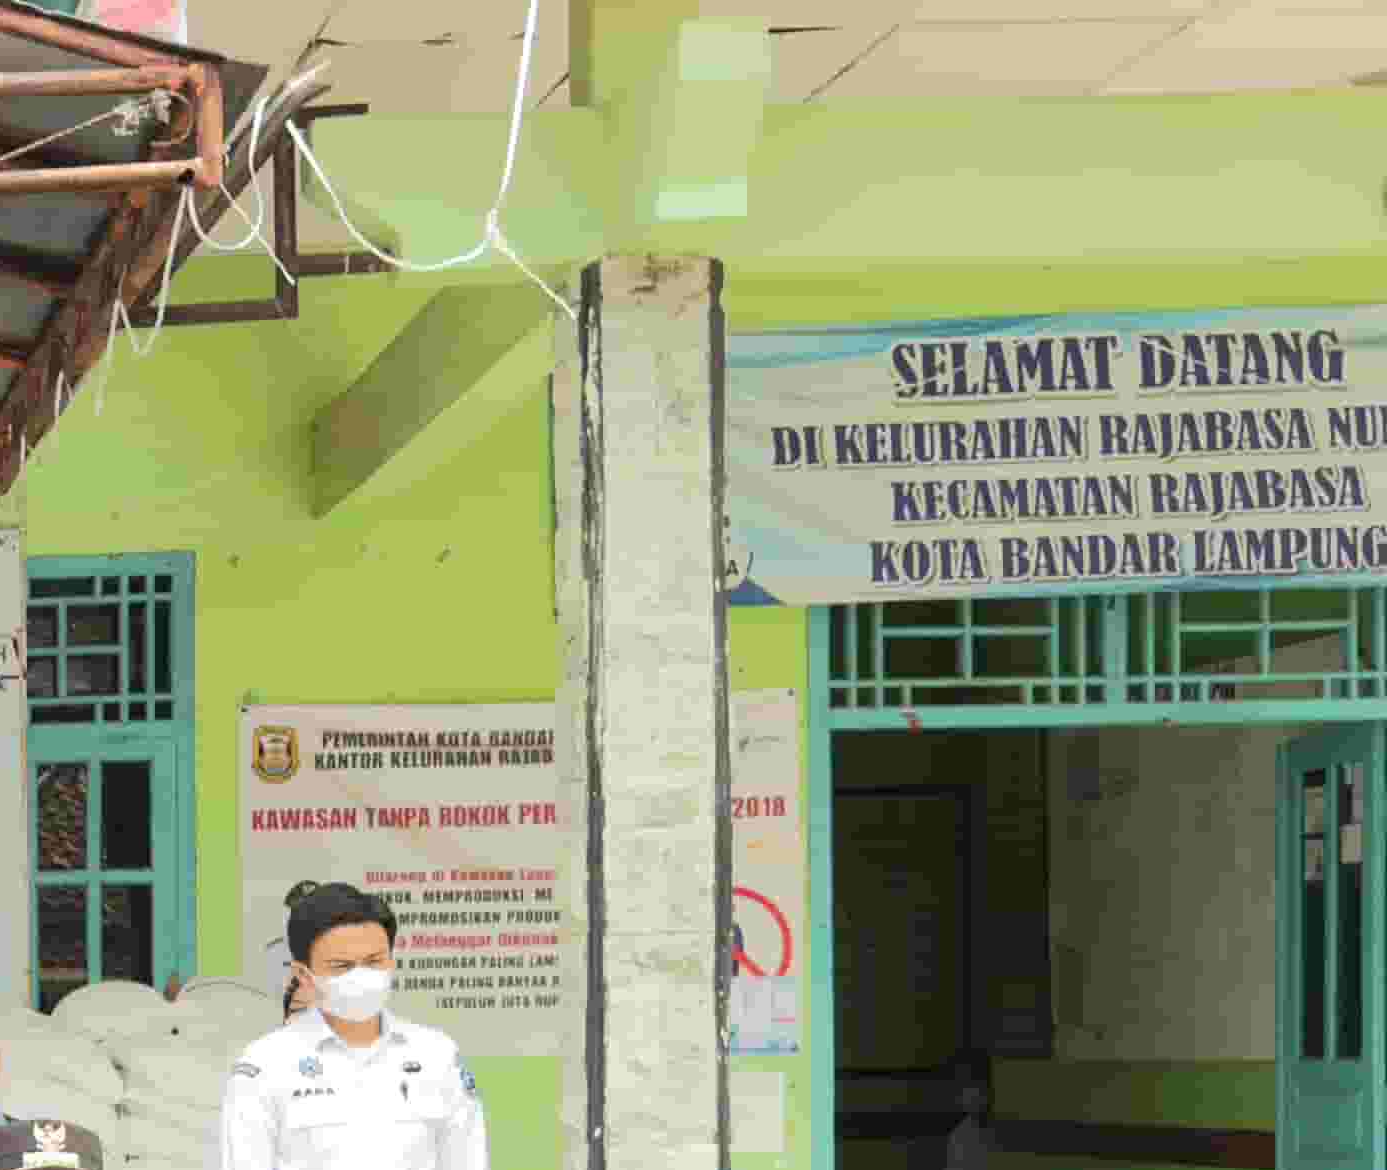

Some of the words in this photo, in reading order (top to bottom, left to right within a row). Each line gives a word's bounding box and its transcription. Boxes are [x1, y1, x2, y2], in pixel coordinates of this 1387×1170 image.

[891, 336, 1122, 398] SELAMAT
[1139, 329, 1346, 390] DATANG
[771, 427, 821, 465] DI
[835, 416, 1082, 464] KELURAHAN
[1099, 408, 1313, 458] RAJABASA
[891, 474, 1134, 521] KECAMATAN
[1149, 466, 1364, 518] RAJABASA
[870, 540, 984, 582] KOTA
[1000, 532, 1179, 578] BANDAR
[1194, 526, 1387, 572] LAMPUNG
[251, 807, 357, 832] KAWASAN
[364, 805, 430, 830] TANPA
[439, 803, 509, 828] ROKOK
[732, 796, 787, 817] 2018
